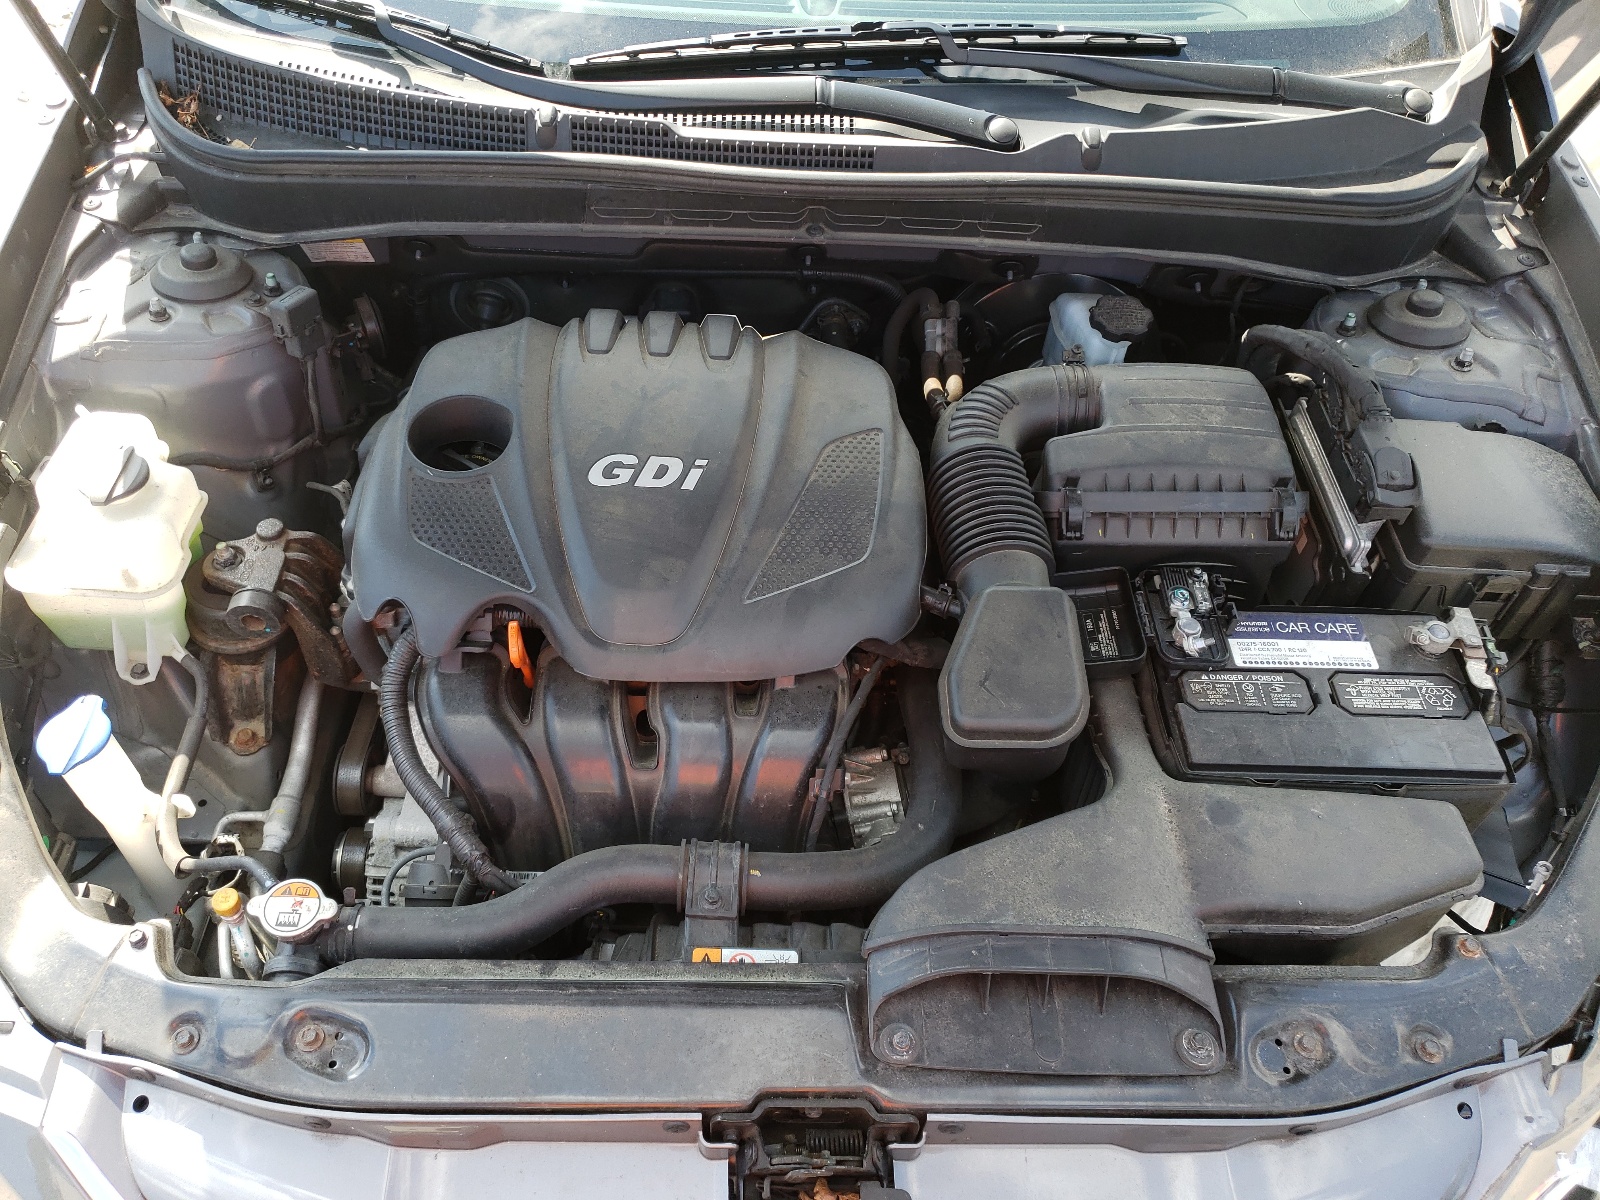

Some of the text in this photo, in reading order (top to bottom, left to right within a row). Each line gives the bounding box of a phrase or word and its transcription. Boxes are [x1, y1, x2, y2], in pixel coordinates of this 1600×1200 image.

[588, 453, 710, 491] GDi
[1276, 621, 1360, 635] CAR CARE
[1251, 674, 1284, 682] POISON
